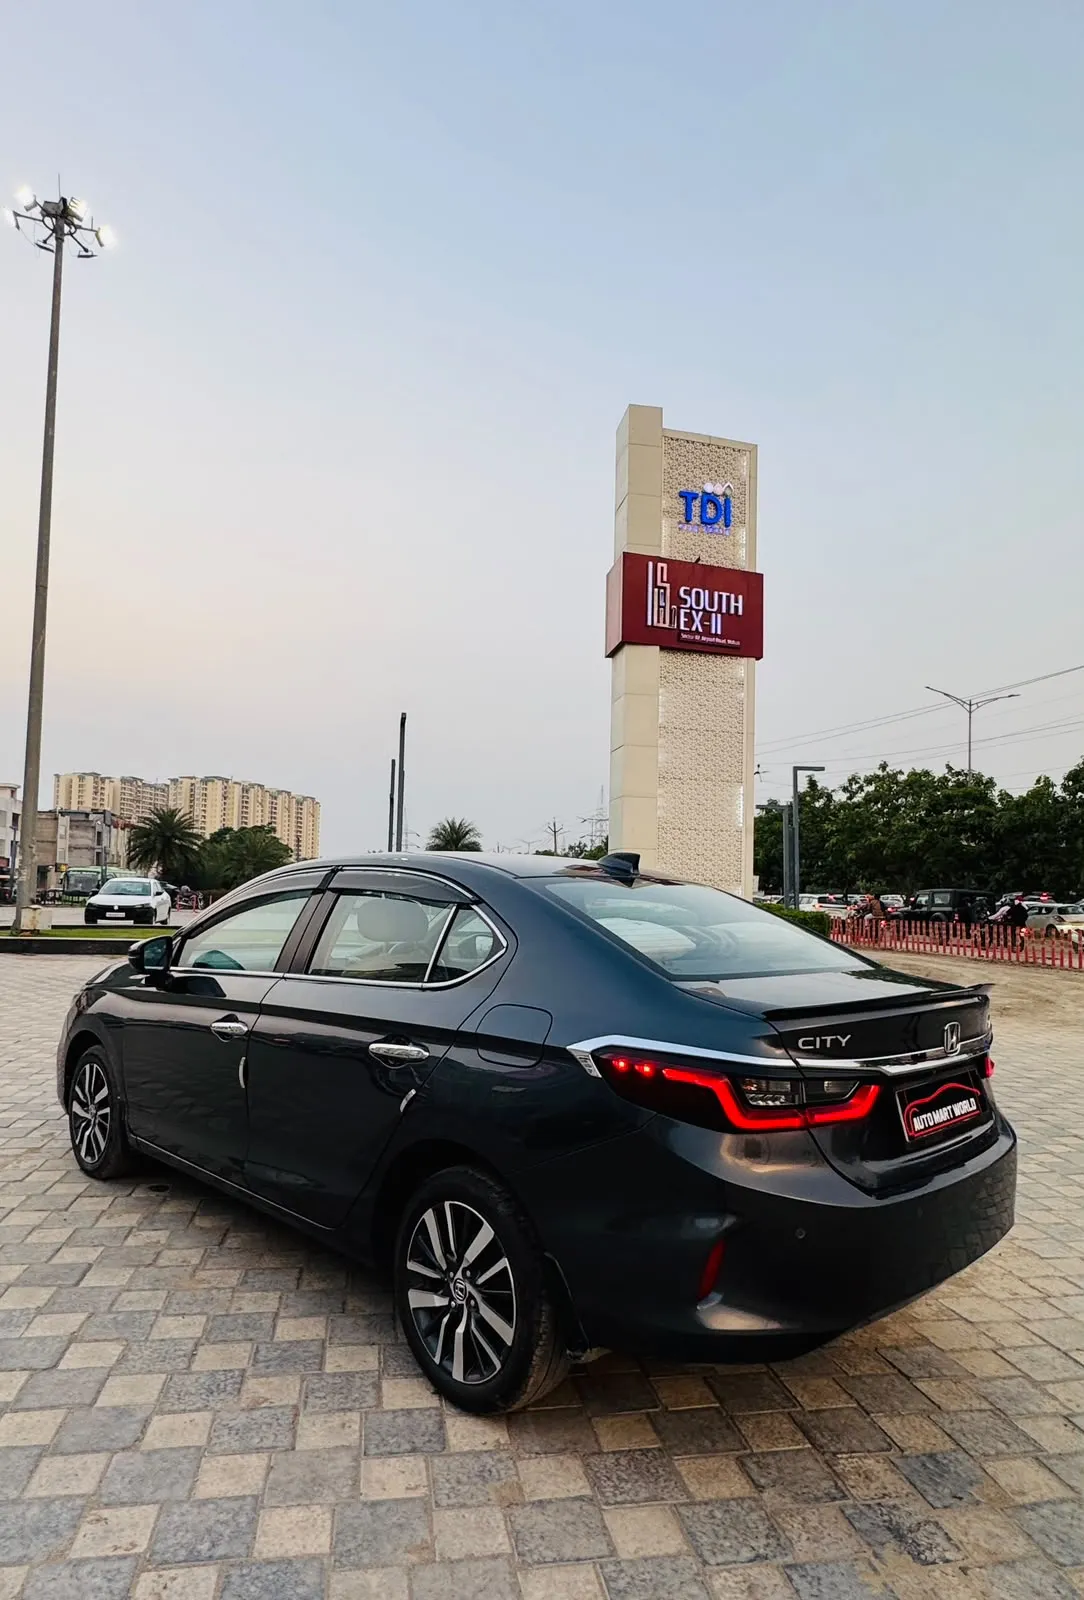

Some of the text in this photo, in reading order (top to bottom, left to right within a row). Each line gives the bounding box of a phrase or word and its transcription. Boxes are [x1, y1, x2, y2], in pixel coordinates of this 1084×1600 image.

[678, 490, 732, 527] TDI
[679, 586, 743, 616] SOUTH
[679, 608, 722, 635] EX-II
[798, 1034, 852, 1050] CITY
[913, 1098, 977, 1131] AUTO MART WORLD
